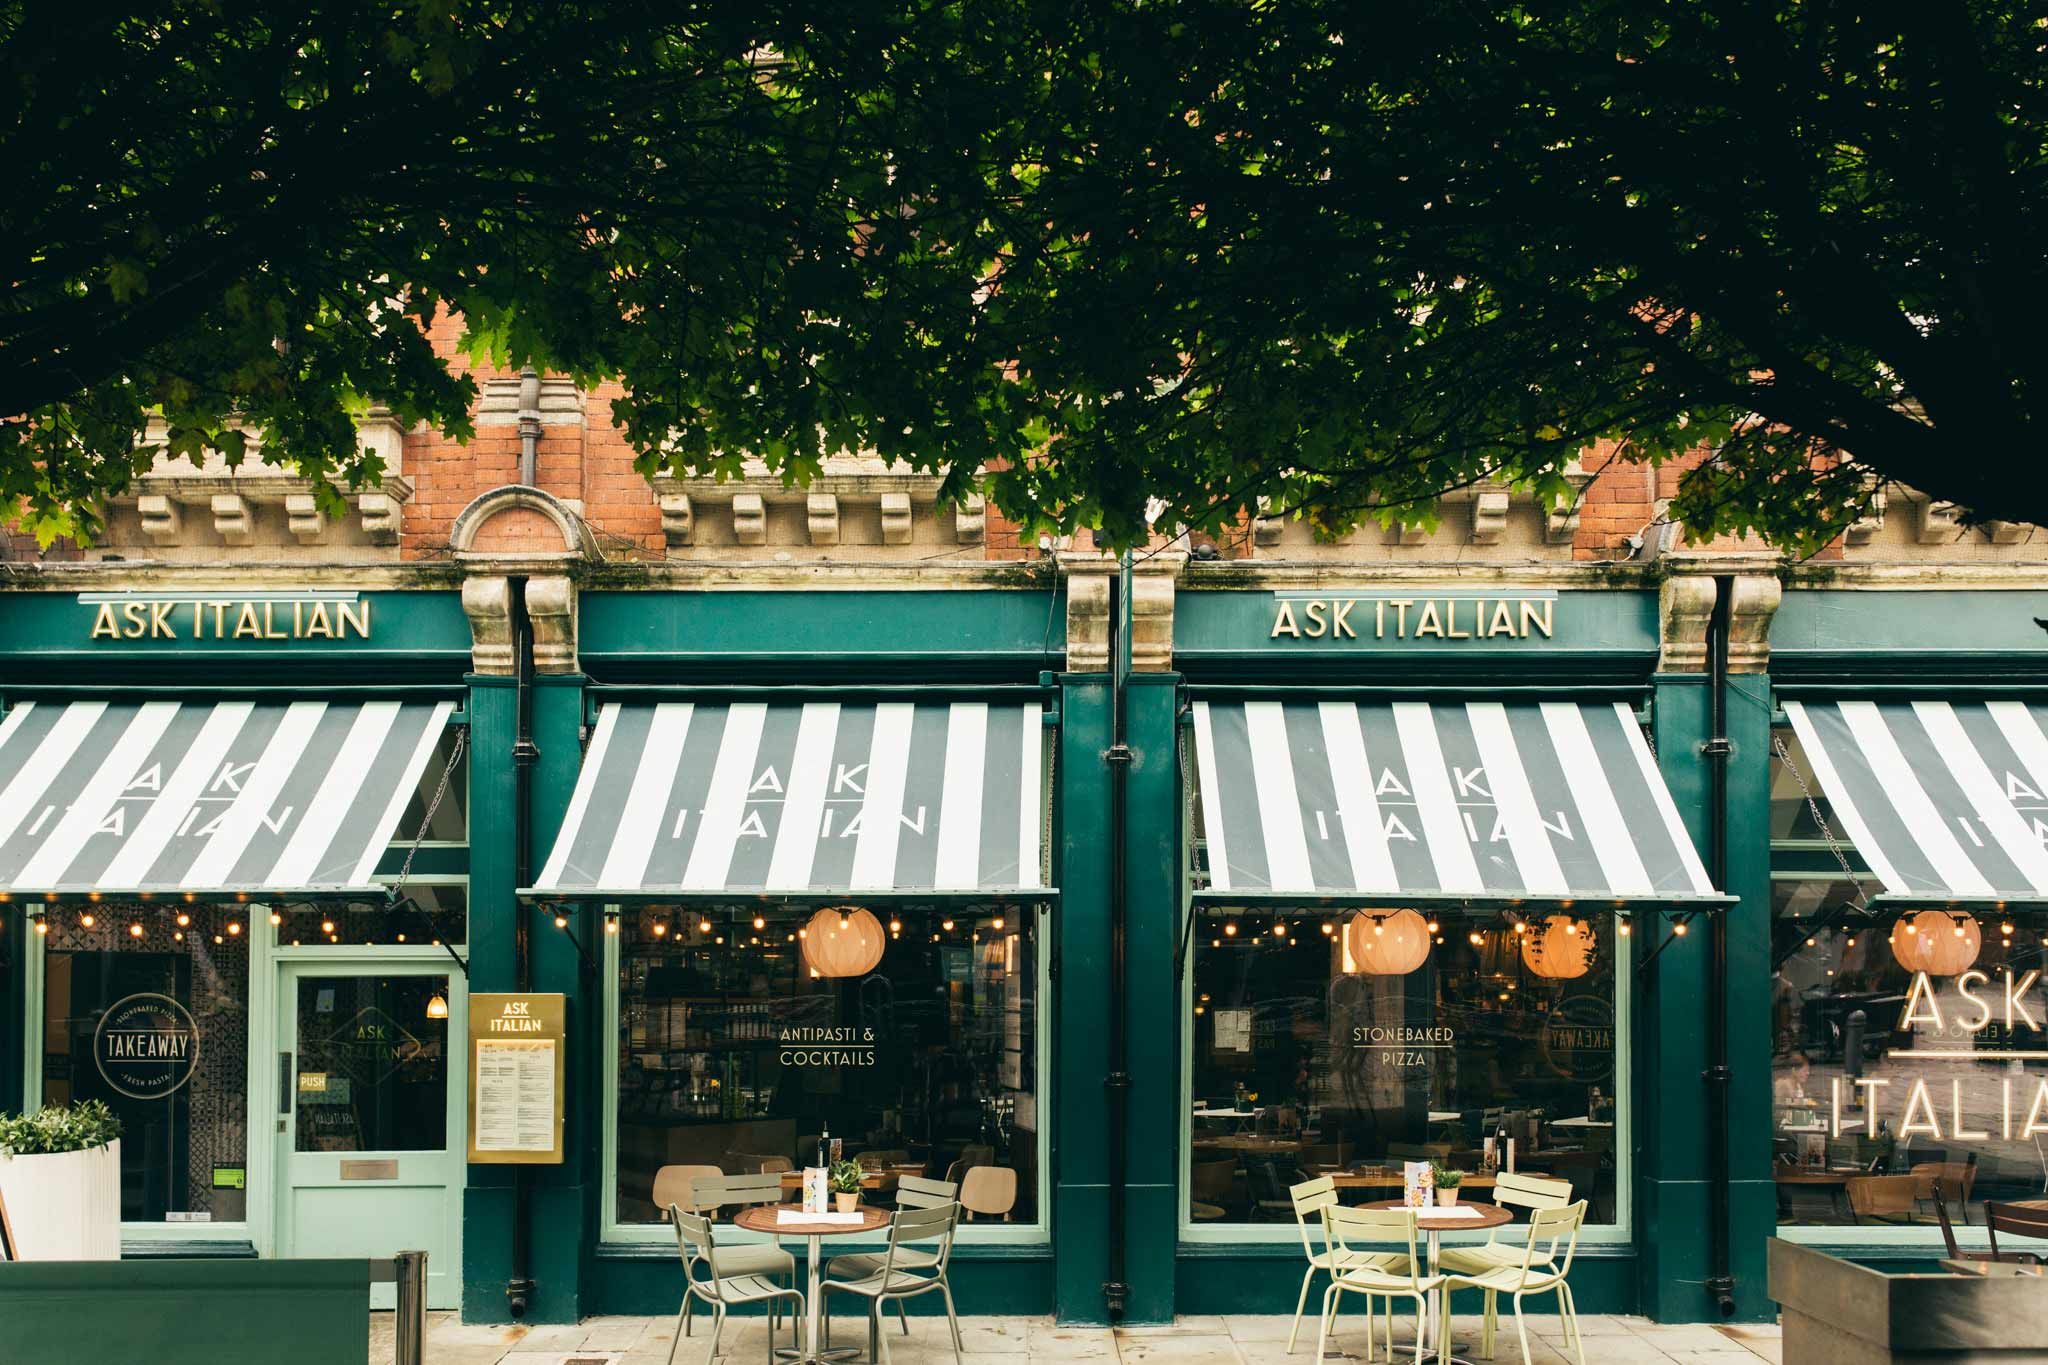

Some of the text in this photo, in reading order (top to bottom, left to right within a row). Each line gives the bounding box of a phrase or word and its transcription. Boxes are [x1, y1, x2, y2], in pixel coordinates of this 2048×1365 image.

[91, 600, 370, 639] ASK ITALIAN
[1270, 600, 1553, 638] ASK ITALIAN
[125, 761, 257, 792] AK
[749, 763, 870, 794] AK
[1375, 766, 1494, 798] AK
[503, 1002, 529, 1015] ASK
[1899, 970, 2041, 1032] ASK
[356, 1025, 385, 1039] ASK
[490, 1019, 542, 1032] ITALIAN
[780, 1027, 875, 1041] ANTIPASTI &
[1353, 1027, 1454, 1041] STONEBAKED
[107, 1034, 188, 1057] TAKEAWAY
[780, 1051, 875, 1066] COCKTAILS
[1382, 1052, 1426, 1066] PIZZA
[300, 1076, 326, 1087] PUSH
